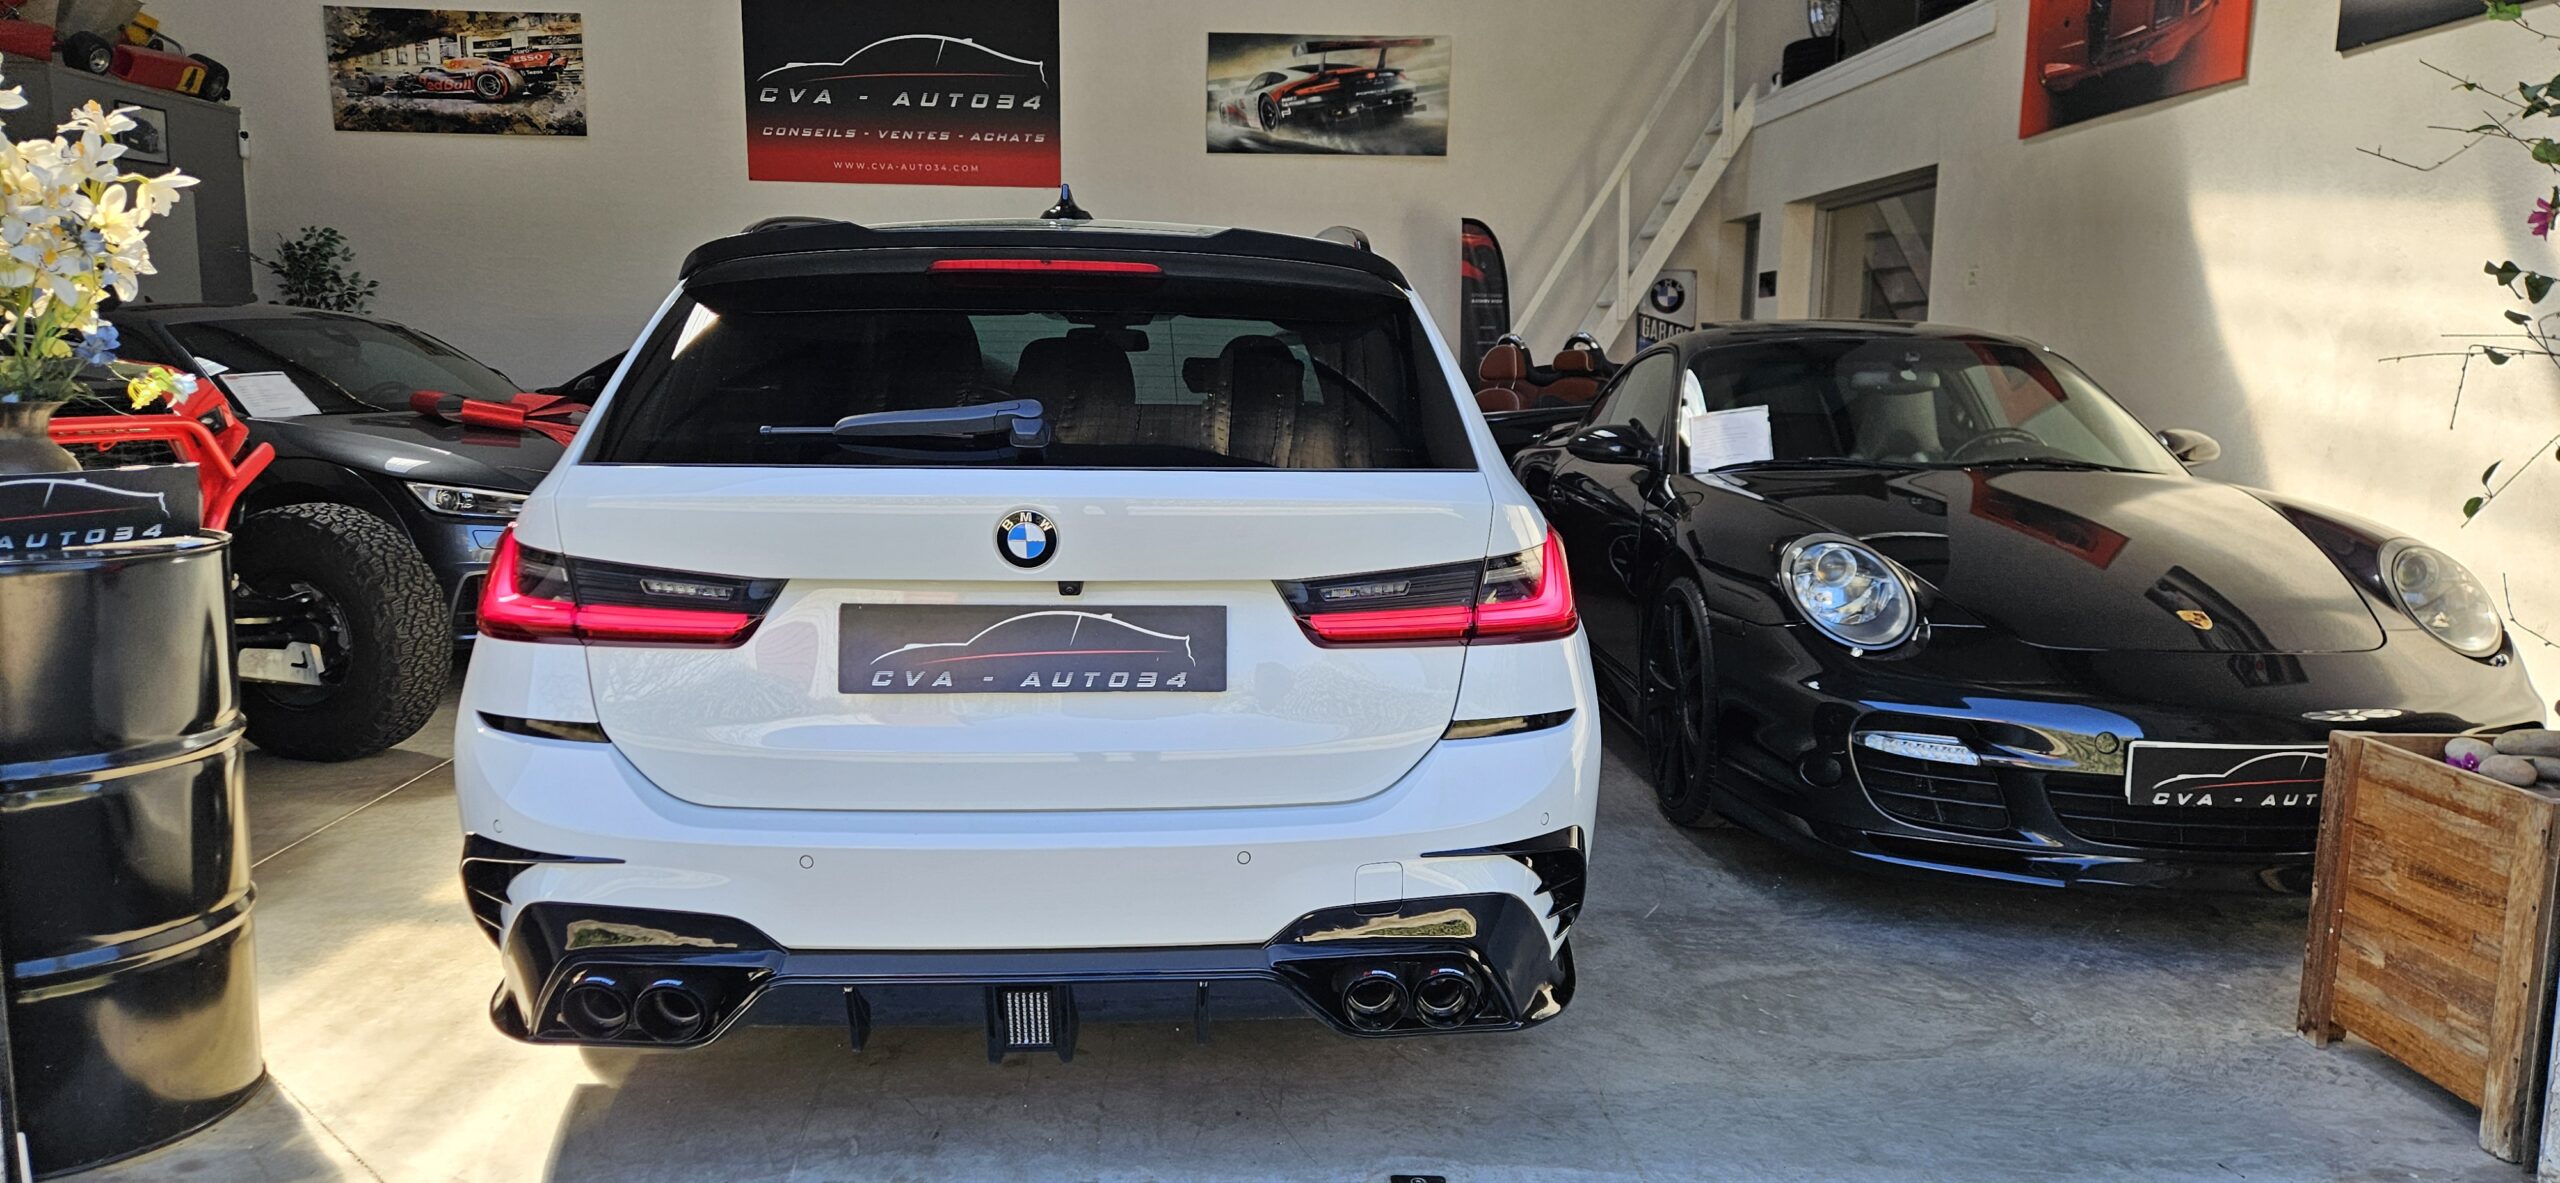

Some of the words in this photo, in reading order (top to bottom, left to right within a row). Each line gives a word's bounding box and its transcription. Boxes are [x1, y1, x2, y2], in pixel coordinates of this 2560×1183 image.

[513, 53, 544, 63] ESSO
[759, 87, 832, 105] CVA
[891, 91, 1042, 110] AUTO34
[762, 126, 857, 138] CONSEILS
[878, 130, 951, 141] VENTES
[969, 132, 1046, 143] ACHATS
[833, 161, 980, 173] WWW.CVA-AUTO34.COM
[1642, 316, 1690, 341] GARA
[1001, 511, 1053, 532] BMW
[871, 670, 954, 688] CVA
[1019, 670, 1189, 689] AUTO34
[2152, 792, 2213, 806] CVA
[2260, 793, 2318, 806] AUT
